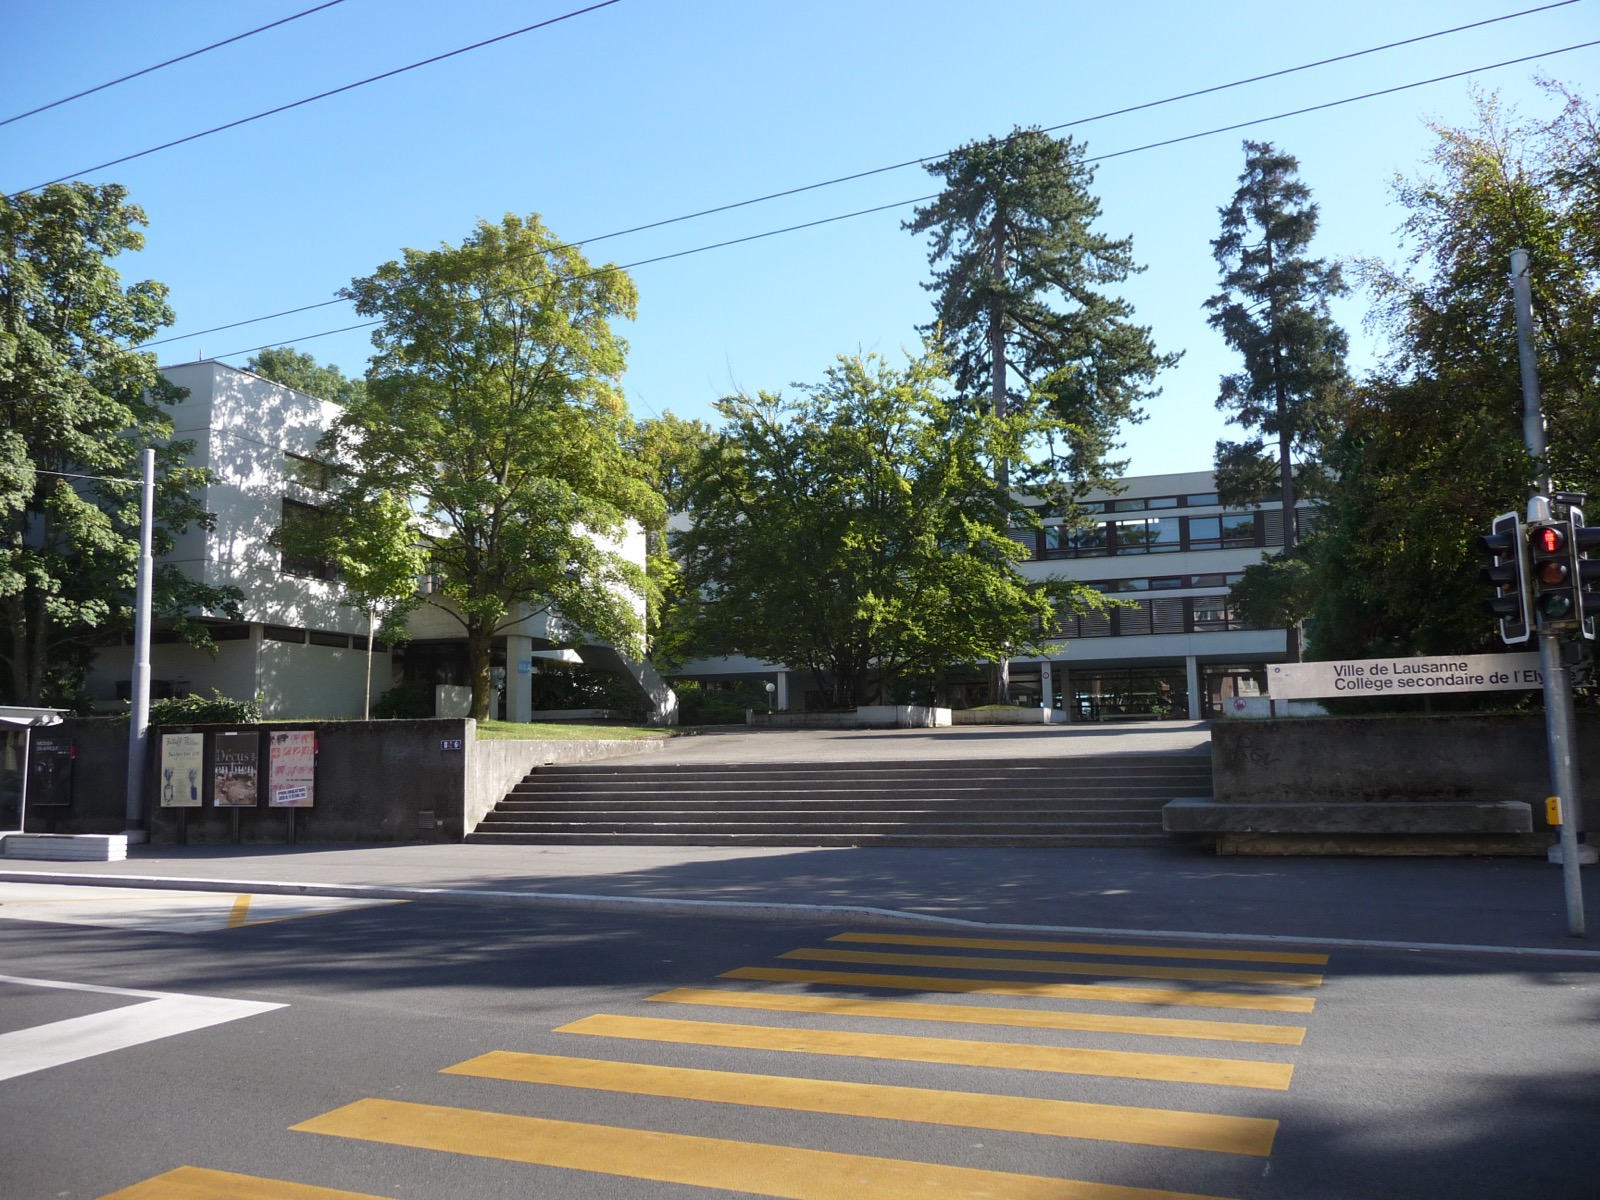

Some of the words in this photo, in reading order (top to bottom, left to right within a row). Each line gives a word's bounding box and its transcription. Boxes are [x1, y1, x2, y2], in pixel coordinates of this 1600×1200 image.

[1333, 663, 1364, 677] Ville
[1369, 663, 1389, 676] de
[1393, 661, 1468, 675] Lausanne
[1334, 677, 1393, 691] Collège
[1397, 672, 1484, 688] secondaire
[1489, 671, 1509, 685] de
